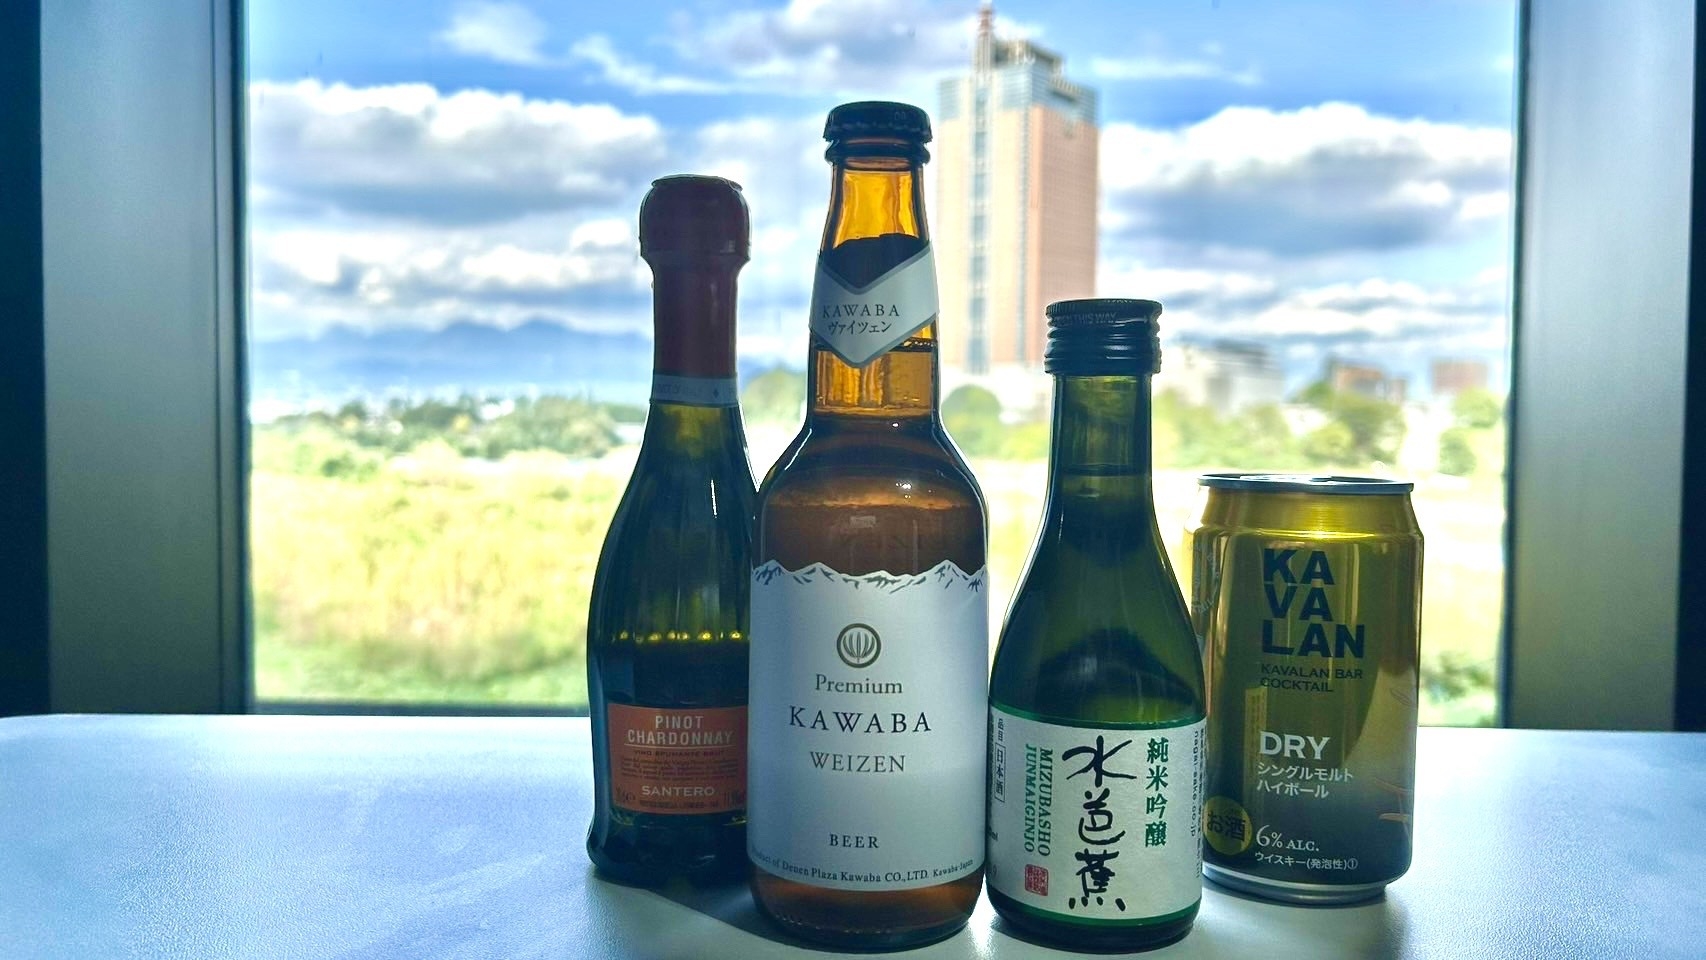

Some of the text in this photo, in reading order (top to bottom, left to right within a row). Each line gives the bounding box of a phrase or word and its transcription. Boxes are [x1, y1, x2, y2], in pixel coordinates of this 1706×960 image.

[822, 304, 900, 318] KAWABA
[1095, 311, 1117, 324] WAY
[828, 320, 892, 335] ヴァイツェン
[1263, 548, 1335, 585] KA
[1264, 584, 1333, 622] VA
[1262, 620, 1365, 659] LAN
[1260, 663, 1363, 680] KAVALAN BAR
[814, 674, 903, 694] Premium
[1259, 677, 1333, 693] COCKTAIL
[655, 715, 704, 729] PINOT
[789, 706, 932, 733] KAWABA
[627, 729, 733, 745] CHARDONNAY
[1259, 731, 1331, 761] DRY
[810, 751, 906, 773] WEIZEN
[1257, 762, 1353, 783] シングルモルト
[641, 785, 715, 797] SANTERO
[1024, 743, 1037, 853] JUNMAIGINJO
[1145, 737, 1169, 848] 純米吟醸
[1256, 780, 1329, 799] ハイボール
[1037, 747, 1053, 857] MIZUBASHO
[1061, 735, 1137, 911] 水芭蕉
[1207, 812, 1247, 842] お酒
[830, 834, 880, 849] BEER
[1256, 824, 1320, 852] 6% ALC.
[782, 861, 809, 876] Denen
[812, 867, 838, 880] Plaza
[840, 871, 881, 882] Kawaba
